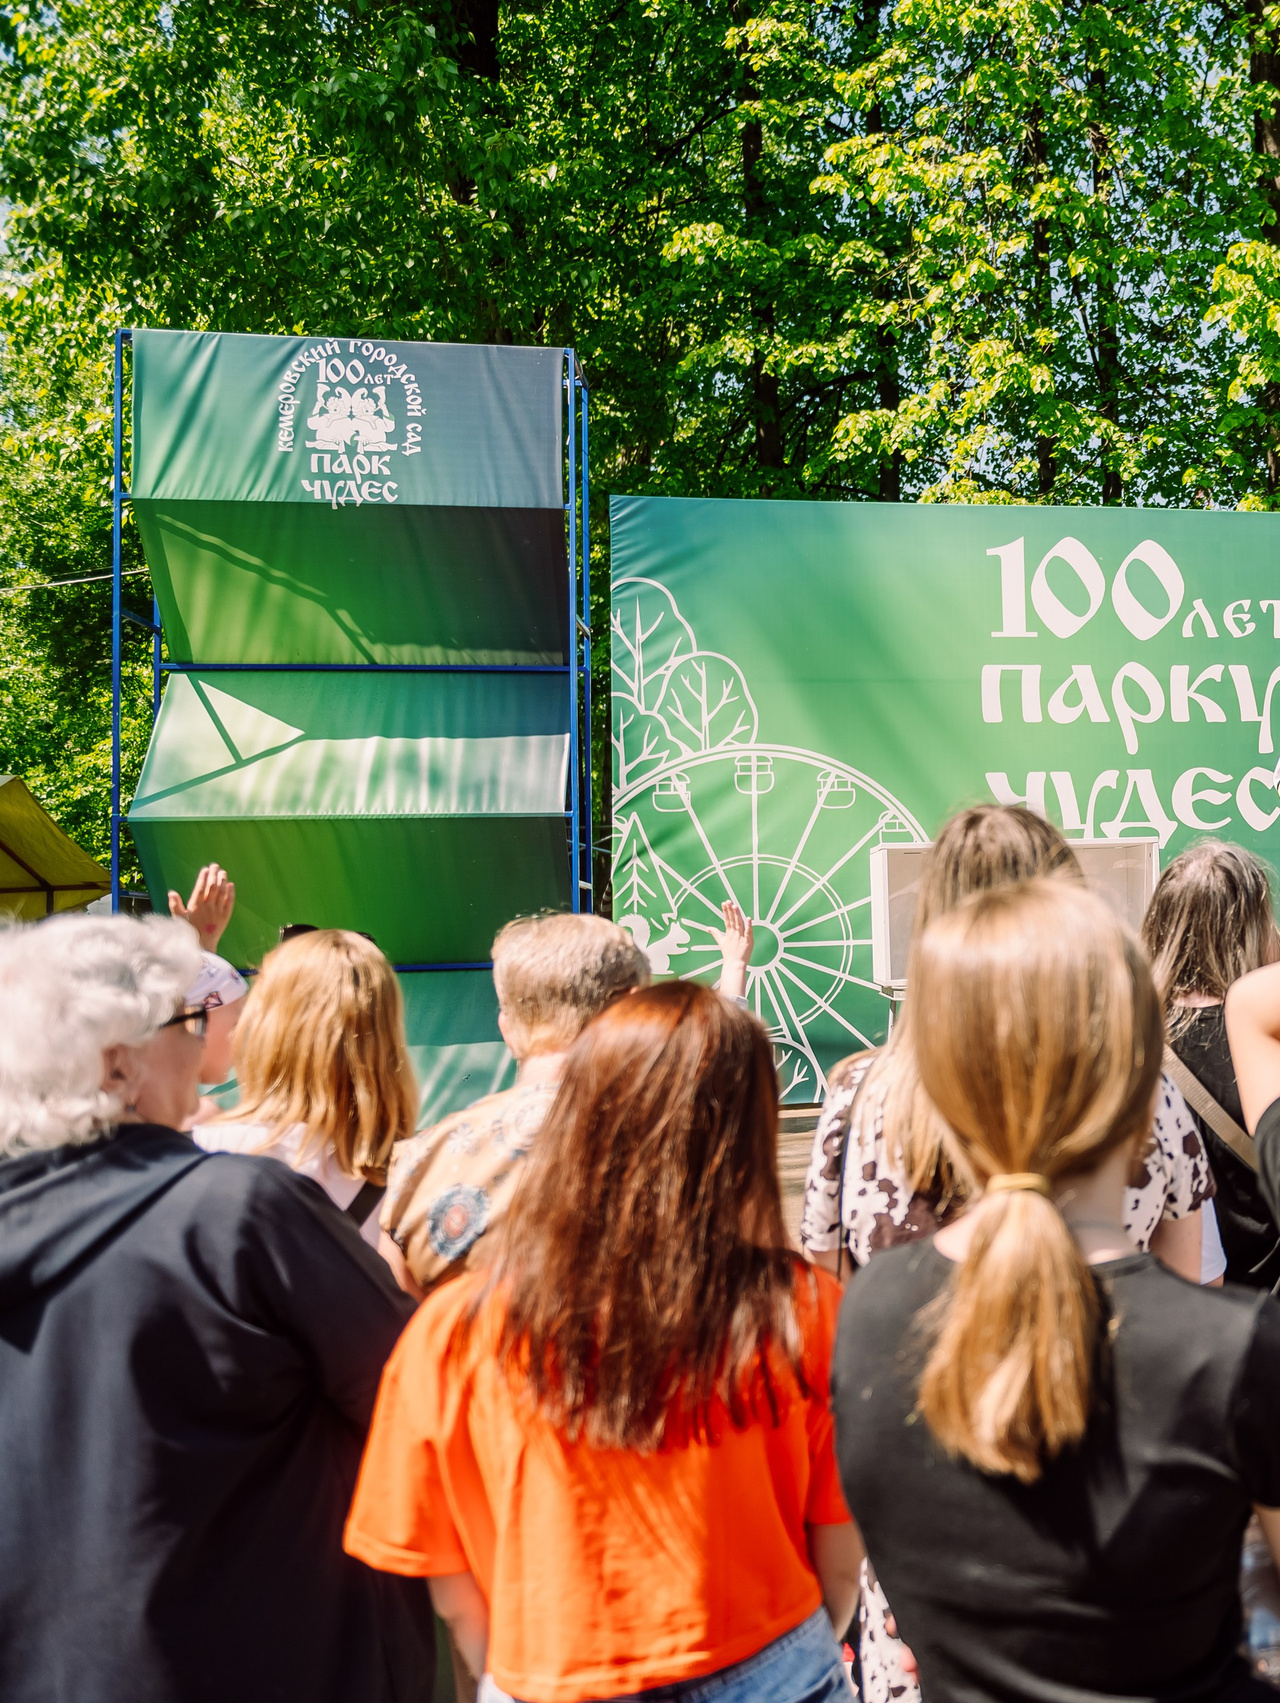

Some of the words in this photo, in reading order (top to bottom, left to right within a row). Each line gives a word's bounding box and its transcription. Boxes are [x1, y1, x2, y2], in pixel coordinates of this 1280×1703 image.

[315, 358, 365, 384] 100
[364, 373, 394, 385] ЛЕТ
[311, 453, 391, 484] ПАРК
[301, 480, 398, 510] ЧУДЕС
[986, 536, 1185, 641] 100
